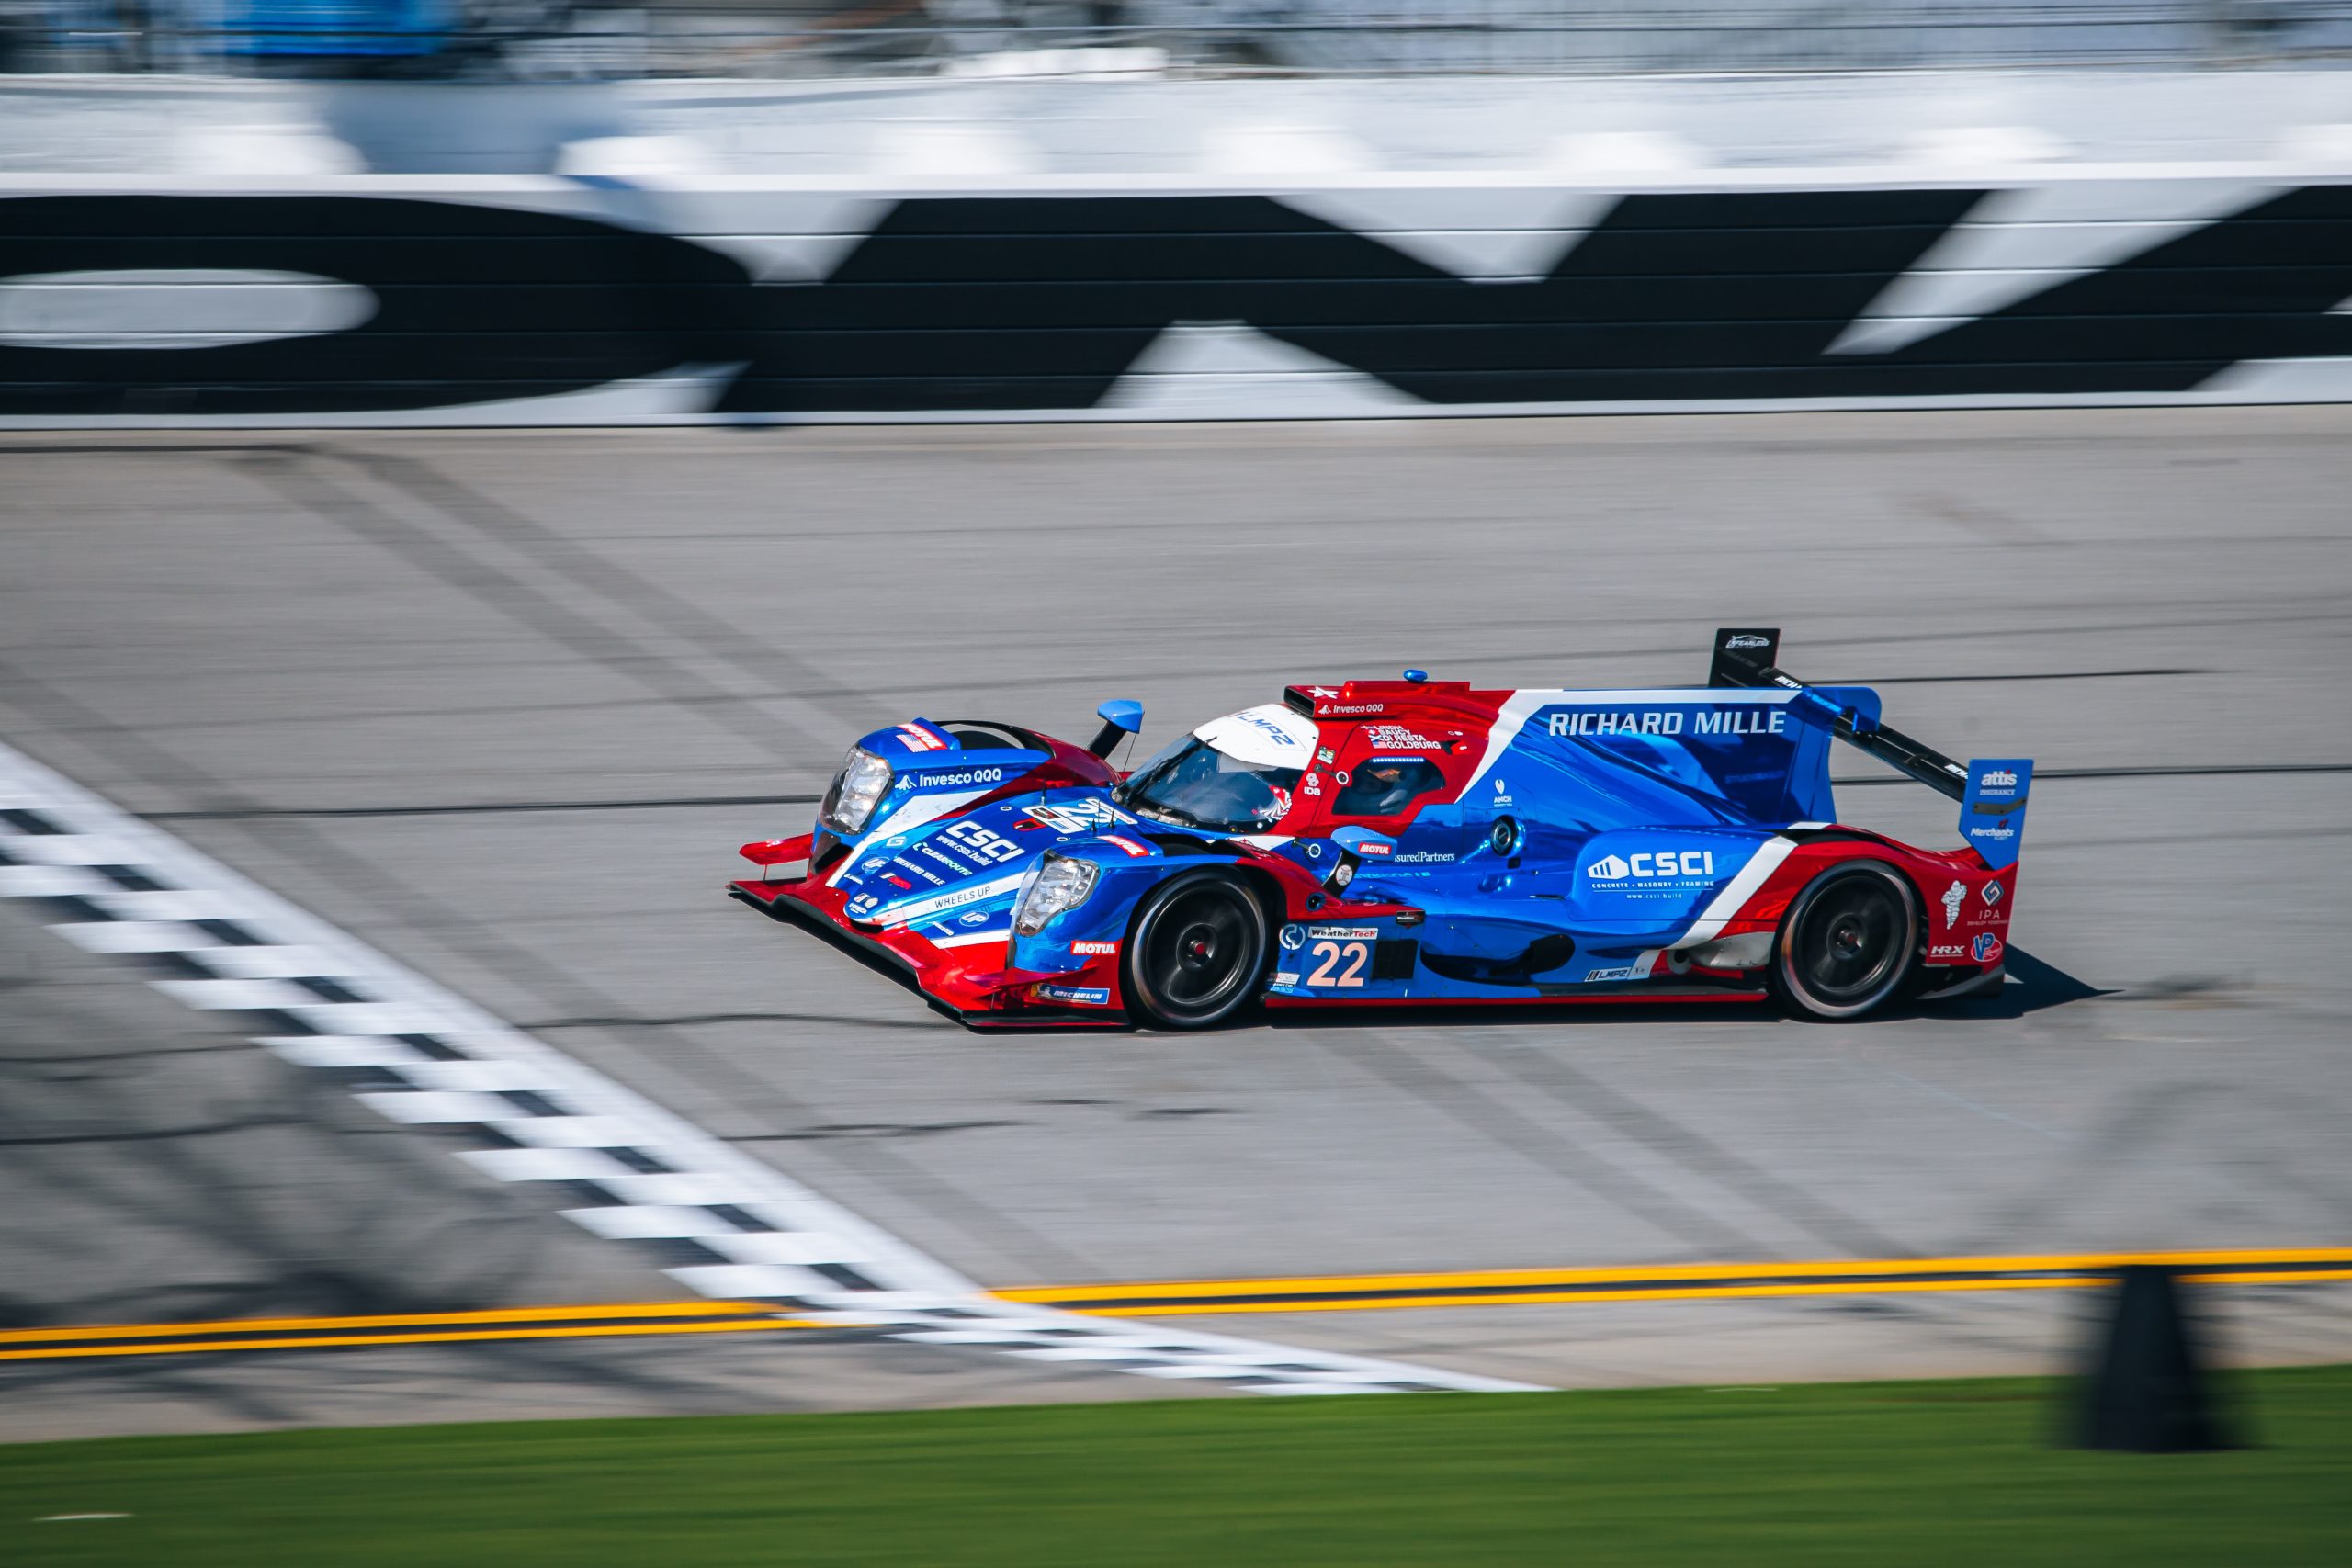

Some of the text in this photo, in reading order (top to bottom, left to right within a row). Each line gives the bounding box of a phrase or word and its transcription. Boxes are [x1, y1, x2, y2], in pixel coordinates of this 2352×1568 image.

[1333, 704, 1384, 714] Invesco QQQ
[1549, 711, 1787, 736] RICHARD MILLE
[1386, 741, 1442, 750] GOLDBURG
[920, 768, 1001, 787] Invesco QQQ
[1970, 827, 2015, 837] Merchants
[945, 820, 1026, 863] CSCI
[1359, 843, 1390, 855] MOTUL
[1630, 851, 1714, 877] CSCI
[934, 886, 991, 908] WHEELS UP
[961, 912, 988, 923] UP
[1978, 909, 2001, 920] IPA
[1311, 929, 1376, 938] WeatherTech
[1072, 943, 1116, 954] MOTUL
[1931, 945, 1966, 955] HRX
[1973, 932, 1996, 961] VP
[1307, 942, 1368, 987] 22
[1053, 990, 1103, 1000] MICHELIN
